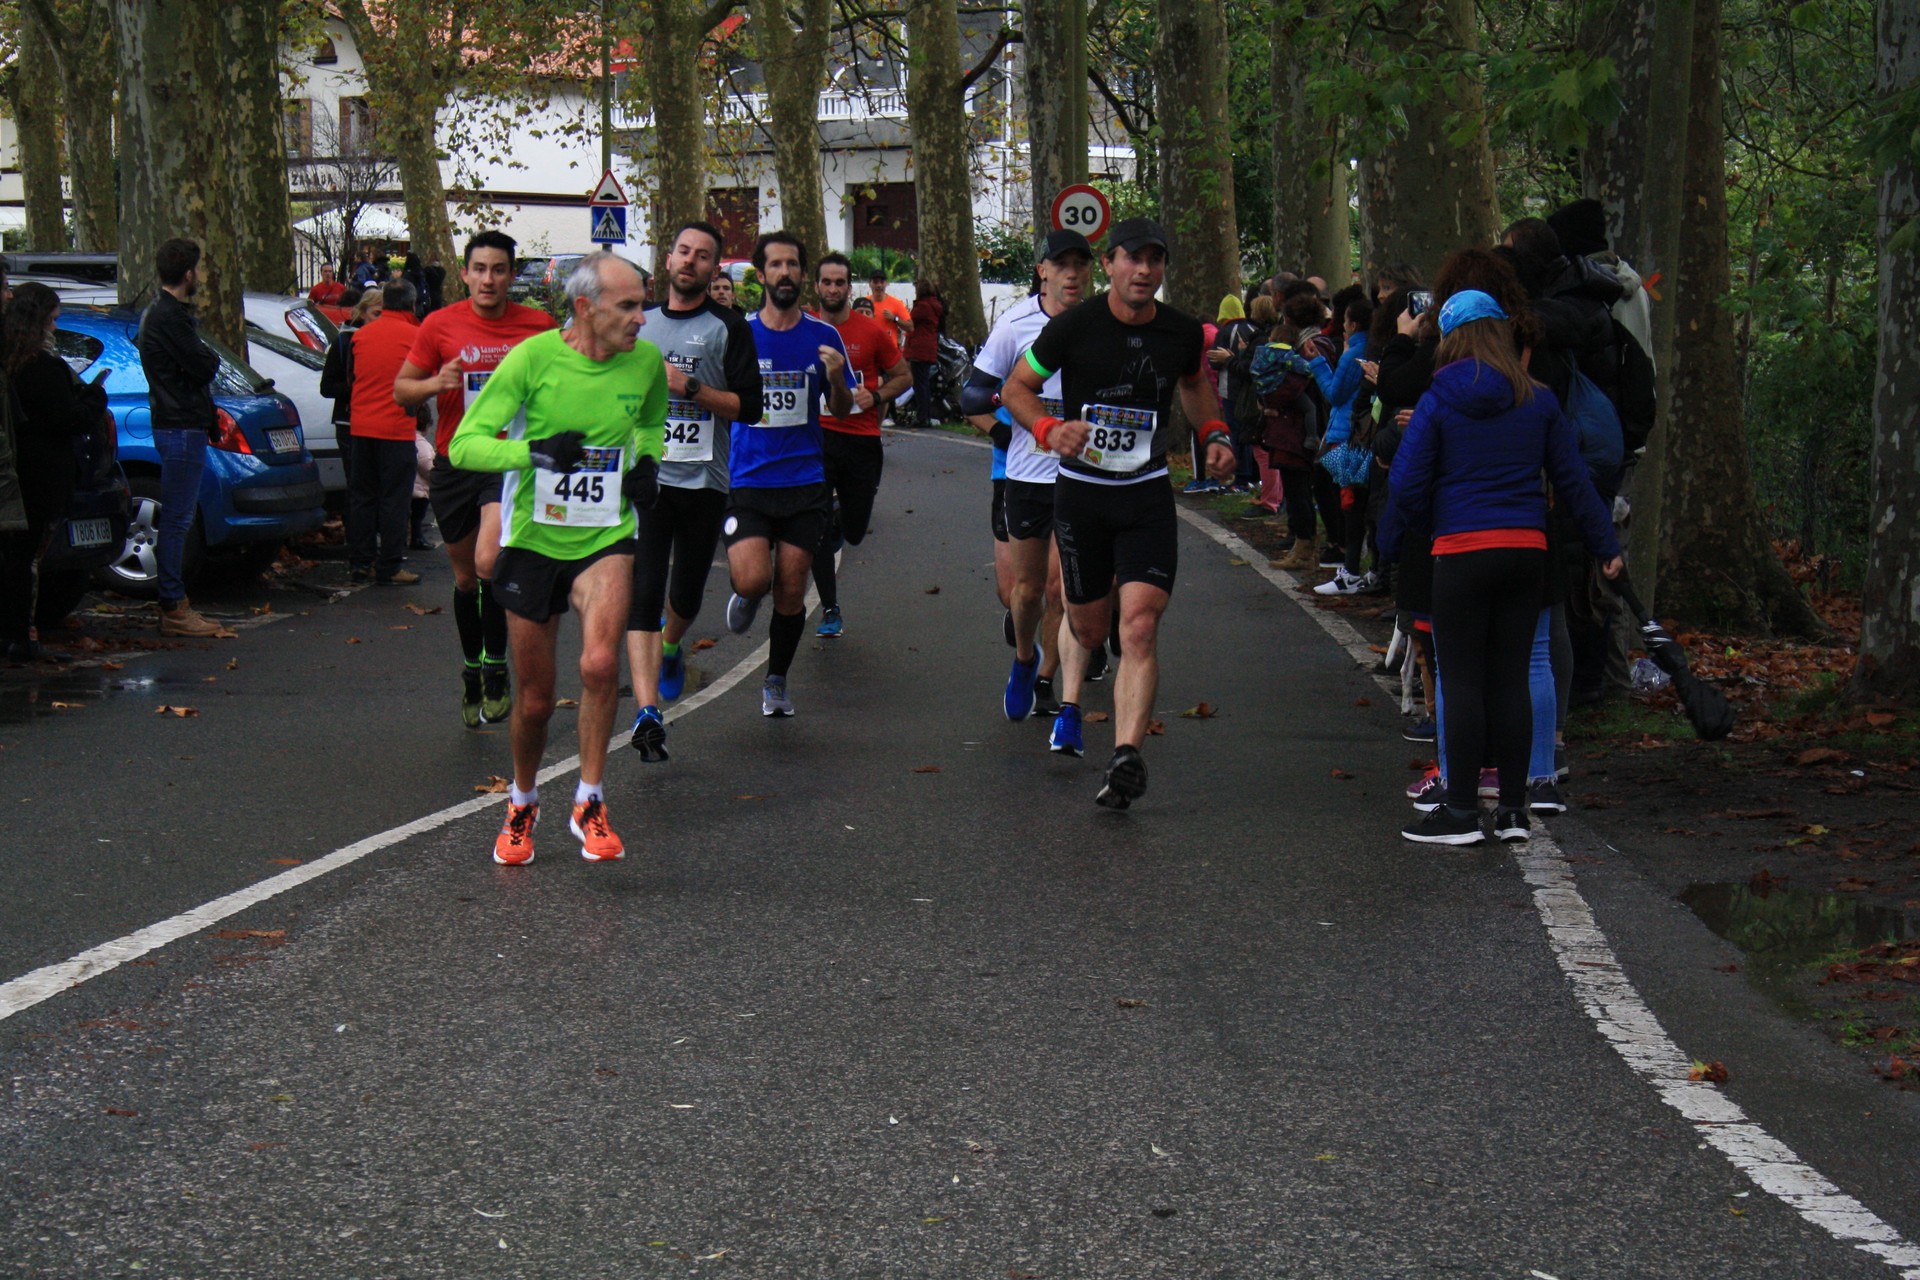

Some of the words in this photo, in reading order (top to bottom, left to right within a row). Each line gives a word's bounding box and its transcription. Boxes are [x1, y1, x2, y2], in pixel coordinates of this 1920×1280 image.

[1065, 206, 1097, 226] 30
[1094, 428, 1137, 452] 833
[554, 474, 604, 503] 445
[75, 522, 96, 542] 1806
